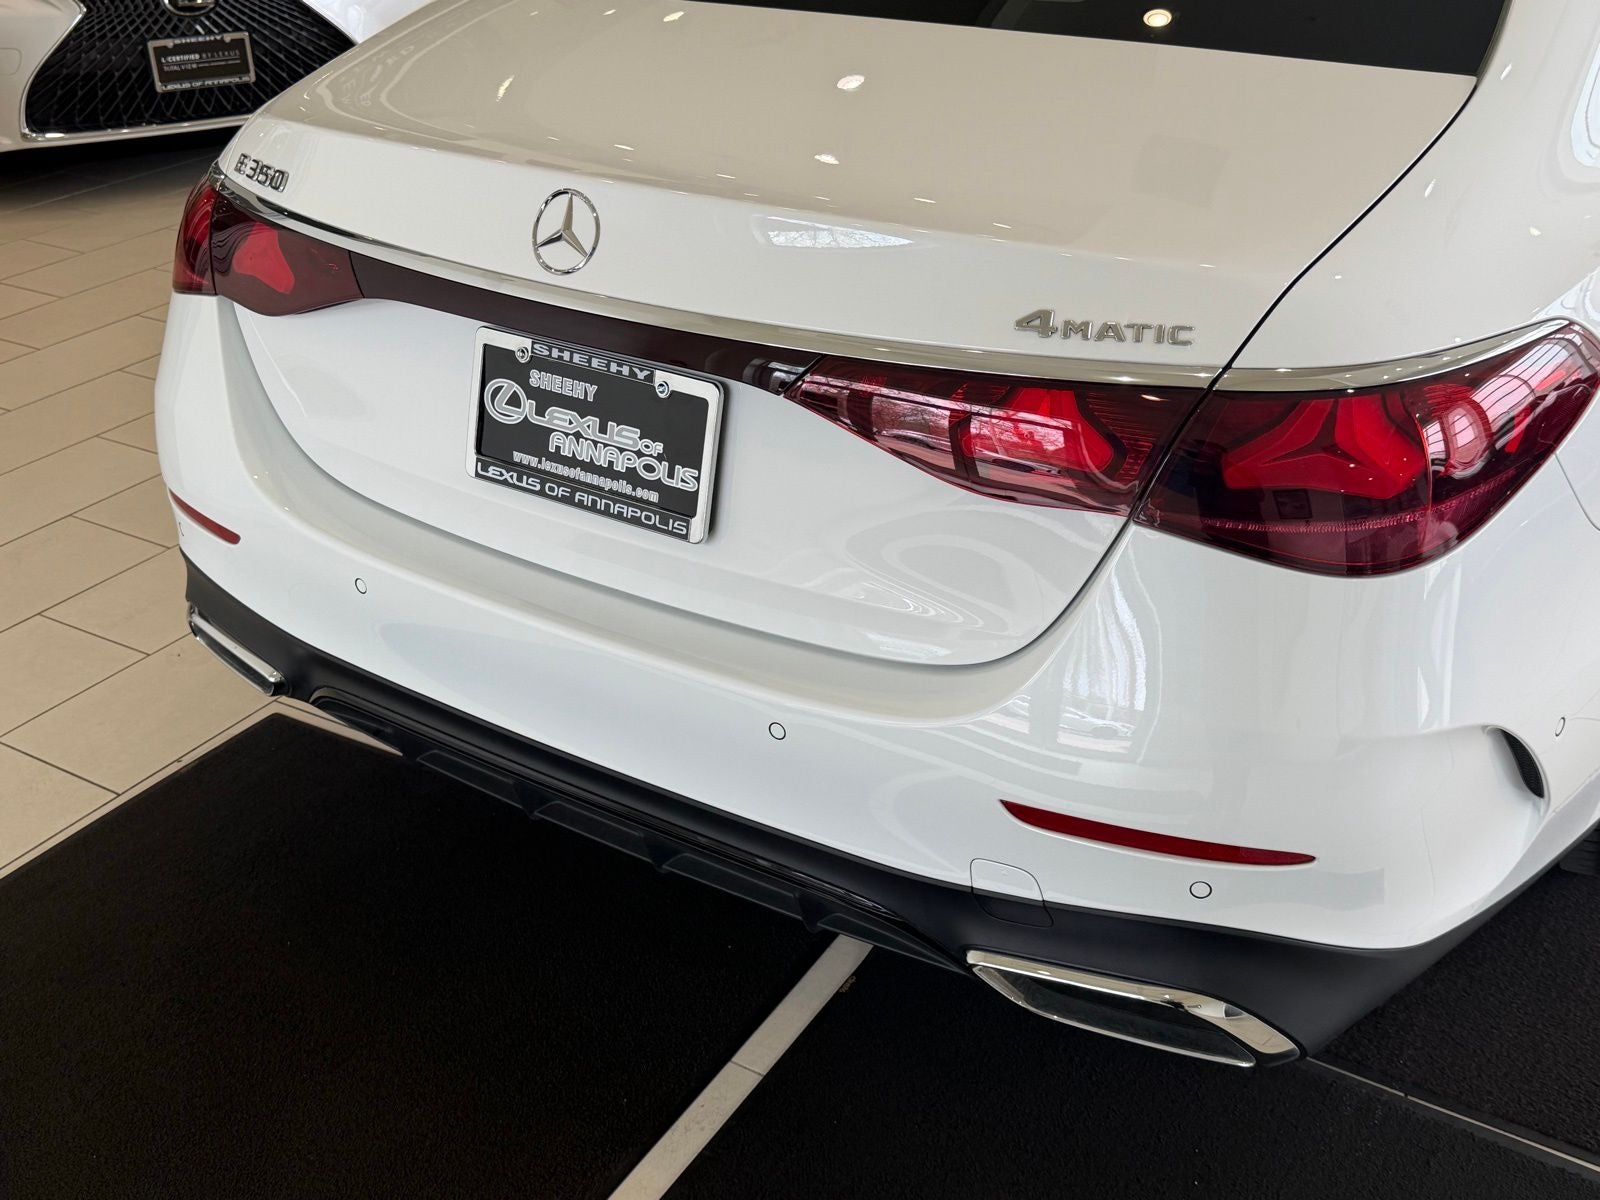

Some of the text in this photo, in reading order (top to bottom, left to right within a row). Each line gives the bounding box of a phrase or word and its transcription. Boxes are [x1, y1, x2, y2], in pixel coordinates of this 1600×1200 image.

[1014, 309, 1195, 346] 4MATIC
[529, 369, 598, 402] SHEEHY
[532, 344, 651, 380] SHEEHY
[526, 400, 641, 451] LEXUS
[512, 450, 659, 503] www.lexusofannapolis.com
[548, 432, 699, 491] ANNAPOLIS
[476, 461, 688, 535] LEXUS OF ANNAPOLIS
